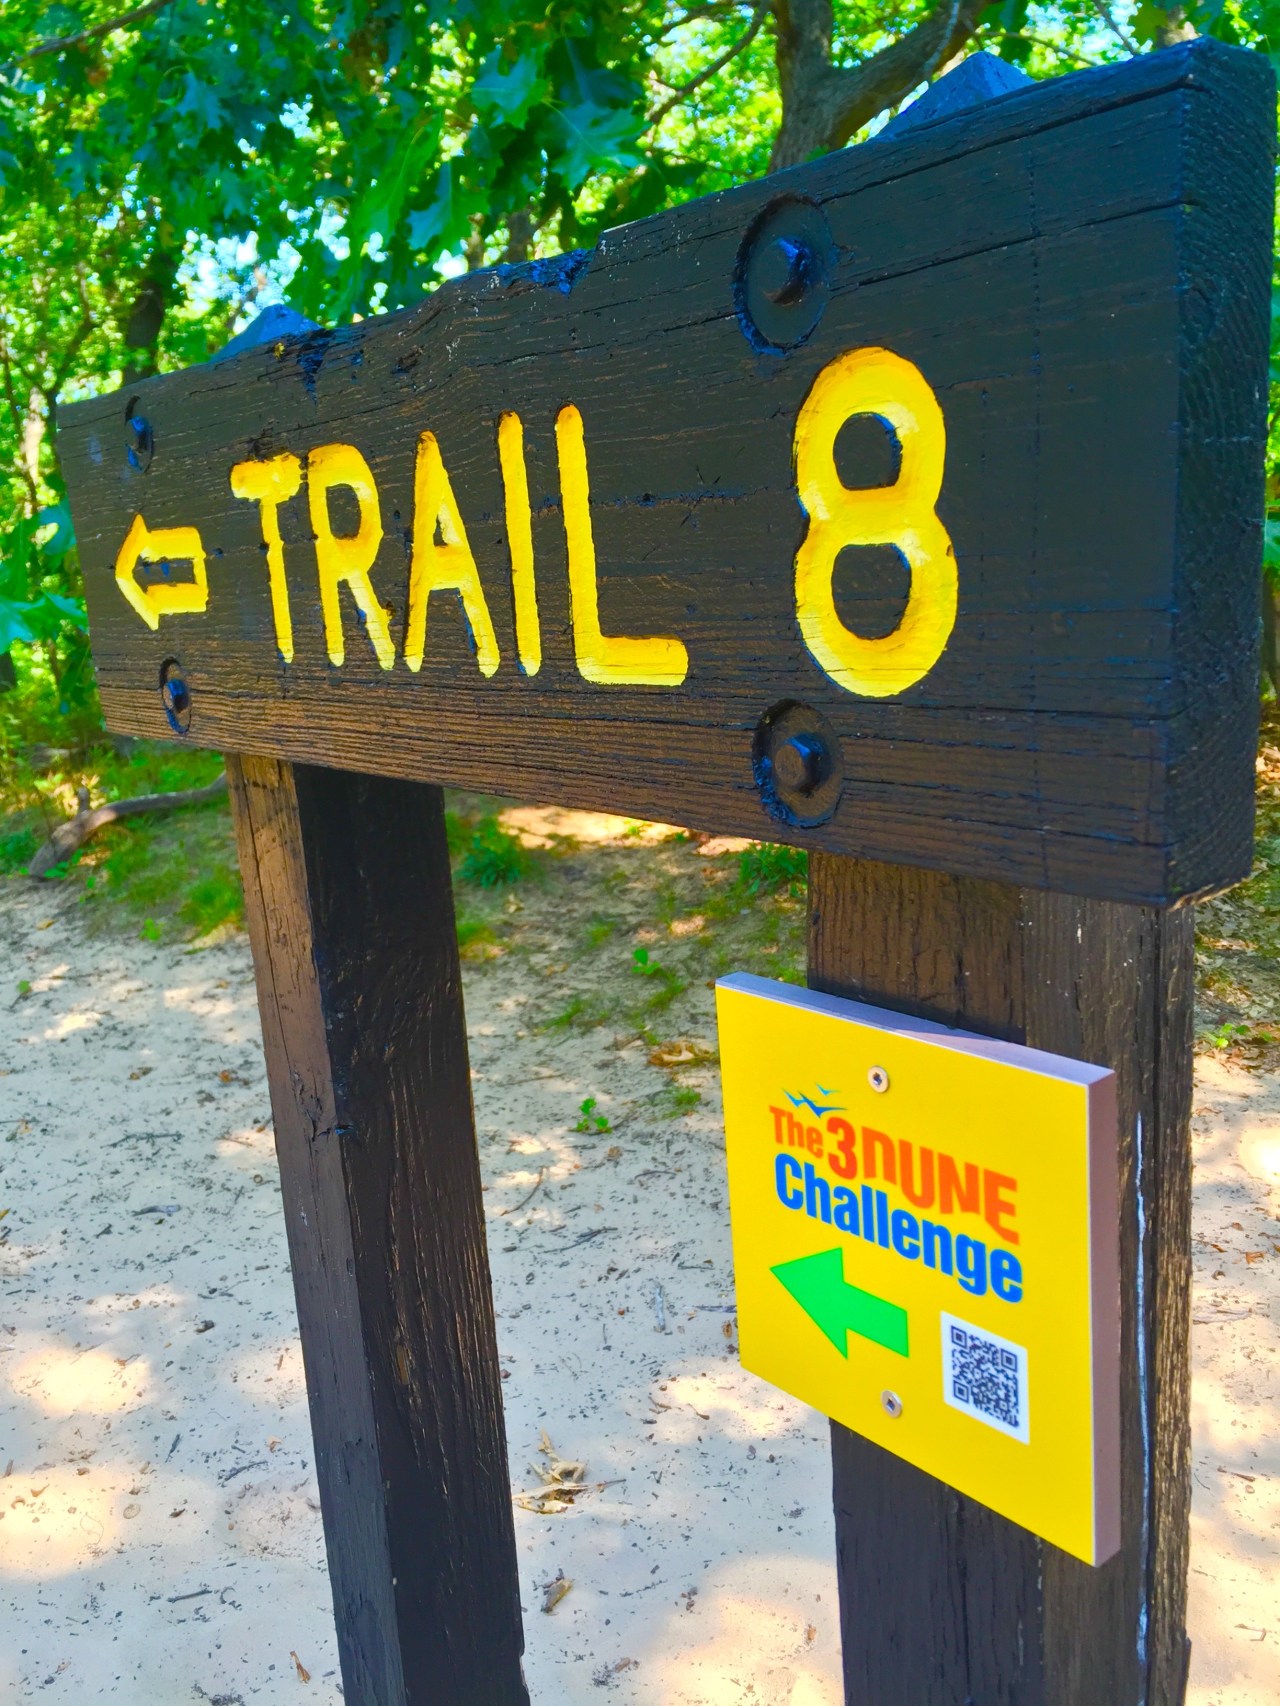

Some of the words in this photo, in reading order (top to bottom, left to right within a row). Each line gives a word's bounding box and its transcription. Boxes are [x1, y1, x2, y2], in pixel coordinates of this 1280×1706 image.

[230, 402, 690, 687] TRAIL
[794, 346, 959, 698] 8
[769, 1105, 823, 1158] The
[775, 1152, 1023, 1303] Challenge
